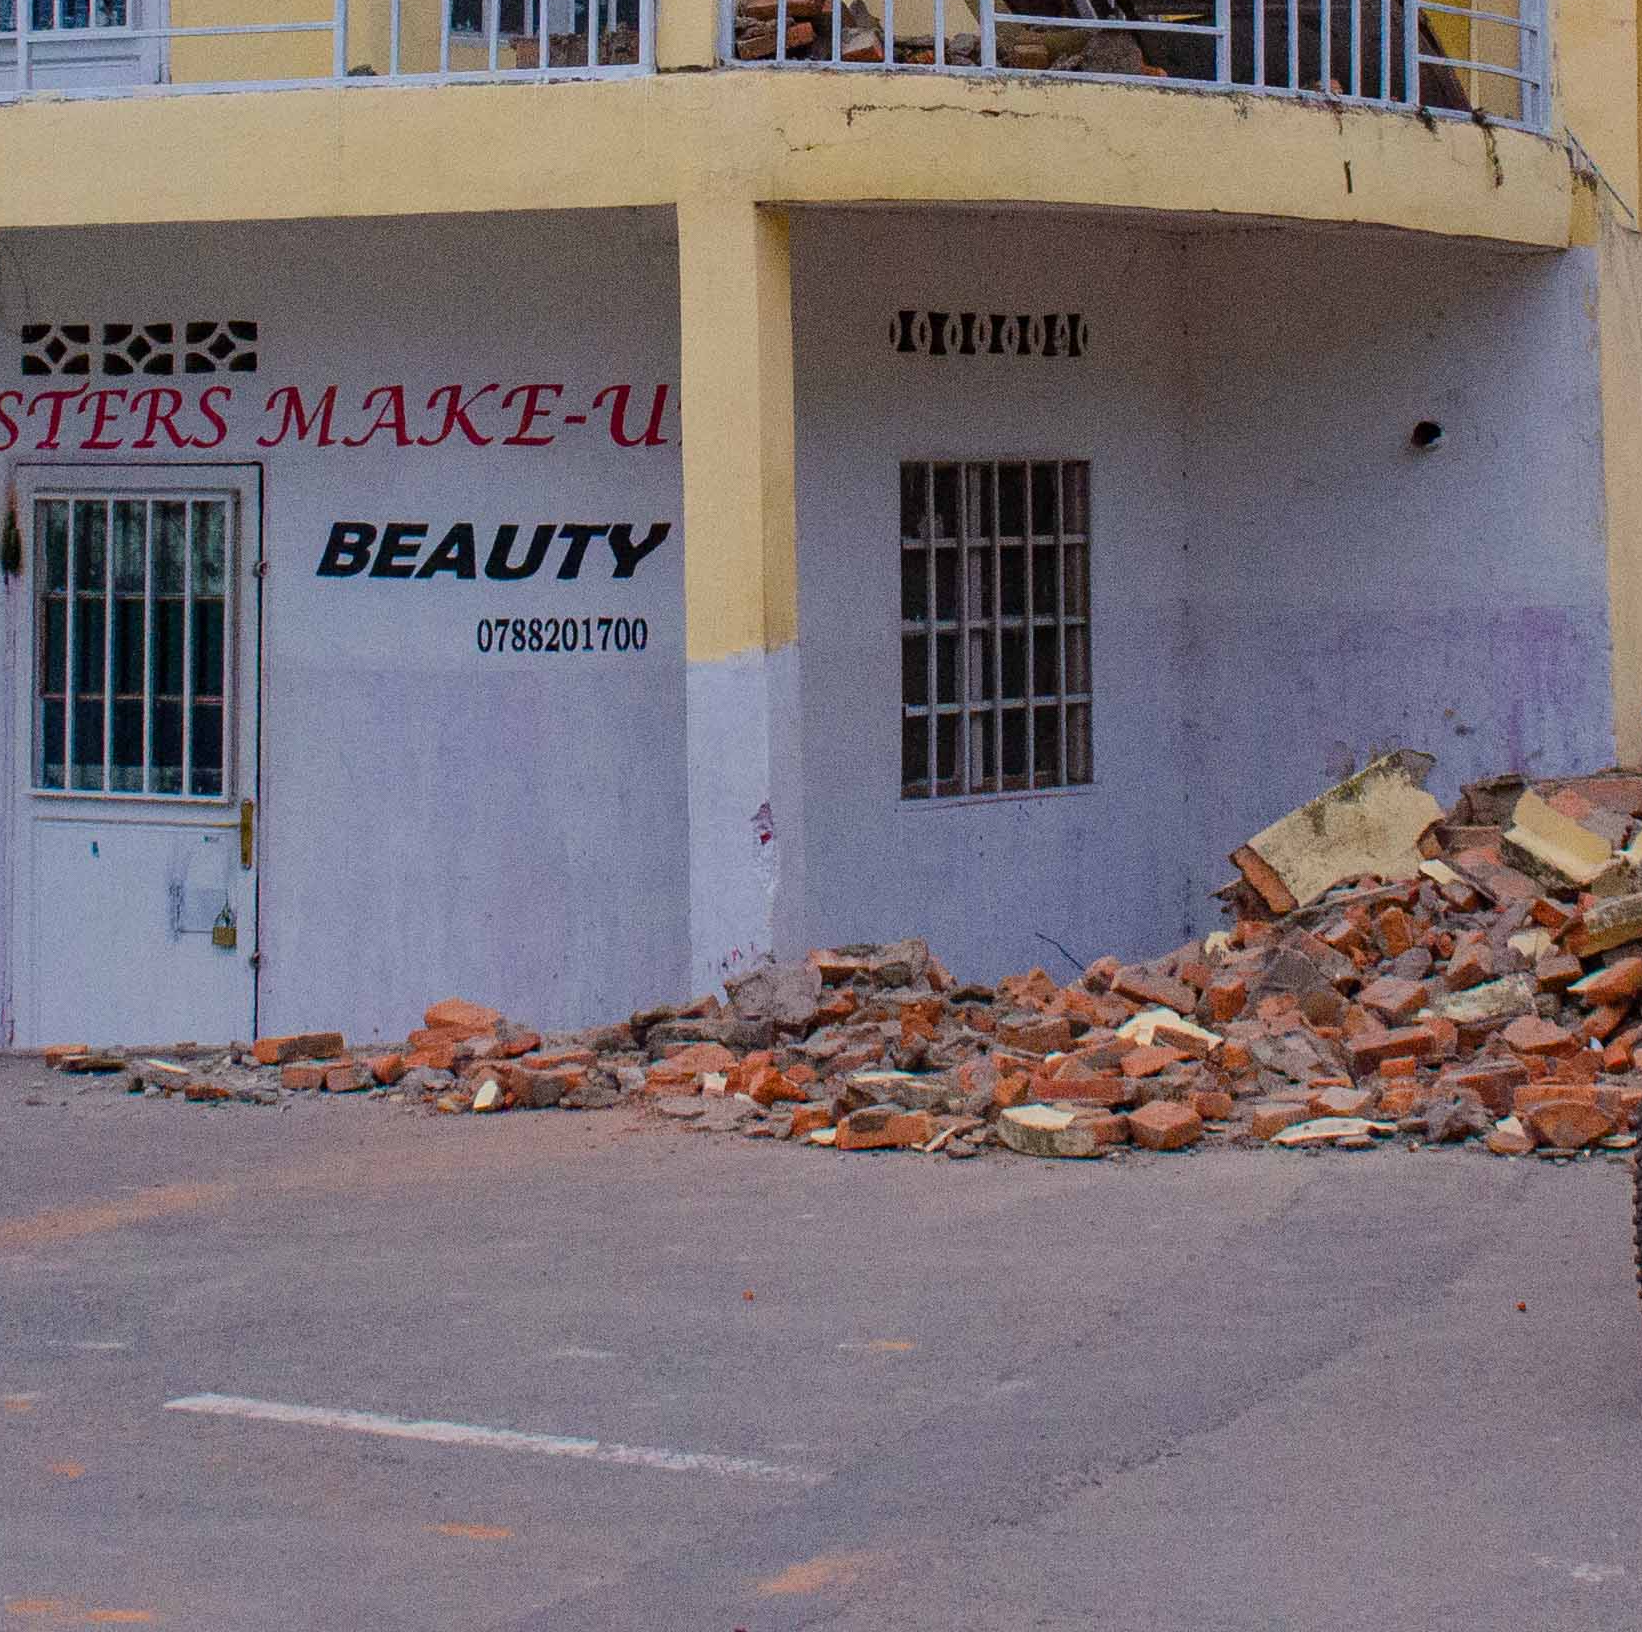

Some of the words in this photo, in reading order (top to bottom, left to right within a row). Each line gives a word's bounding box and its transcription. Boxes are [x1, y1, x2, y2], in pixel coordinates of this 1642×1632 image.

[256, 380, 682, 450] MAKE-U
[315, 522, 672, 580] BEAUTY
[476, 617, 649, 654] 0788201700
